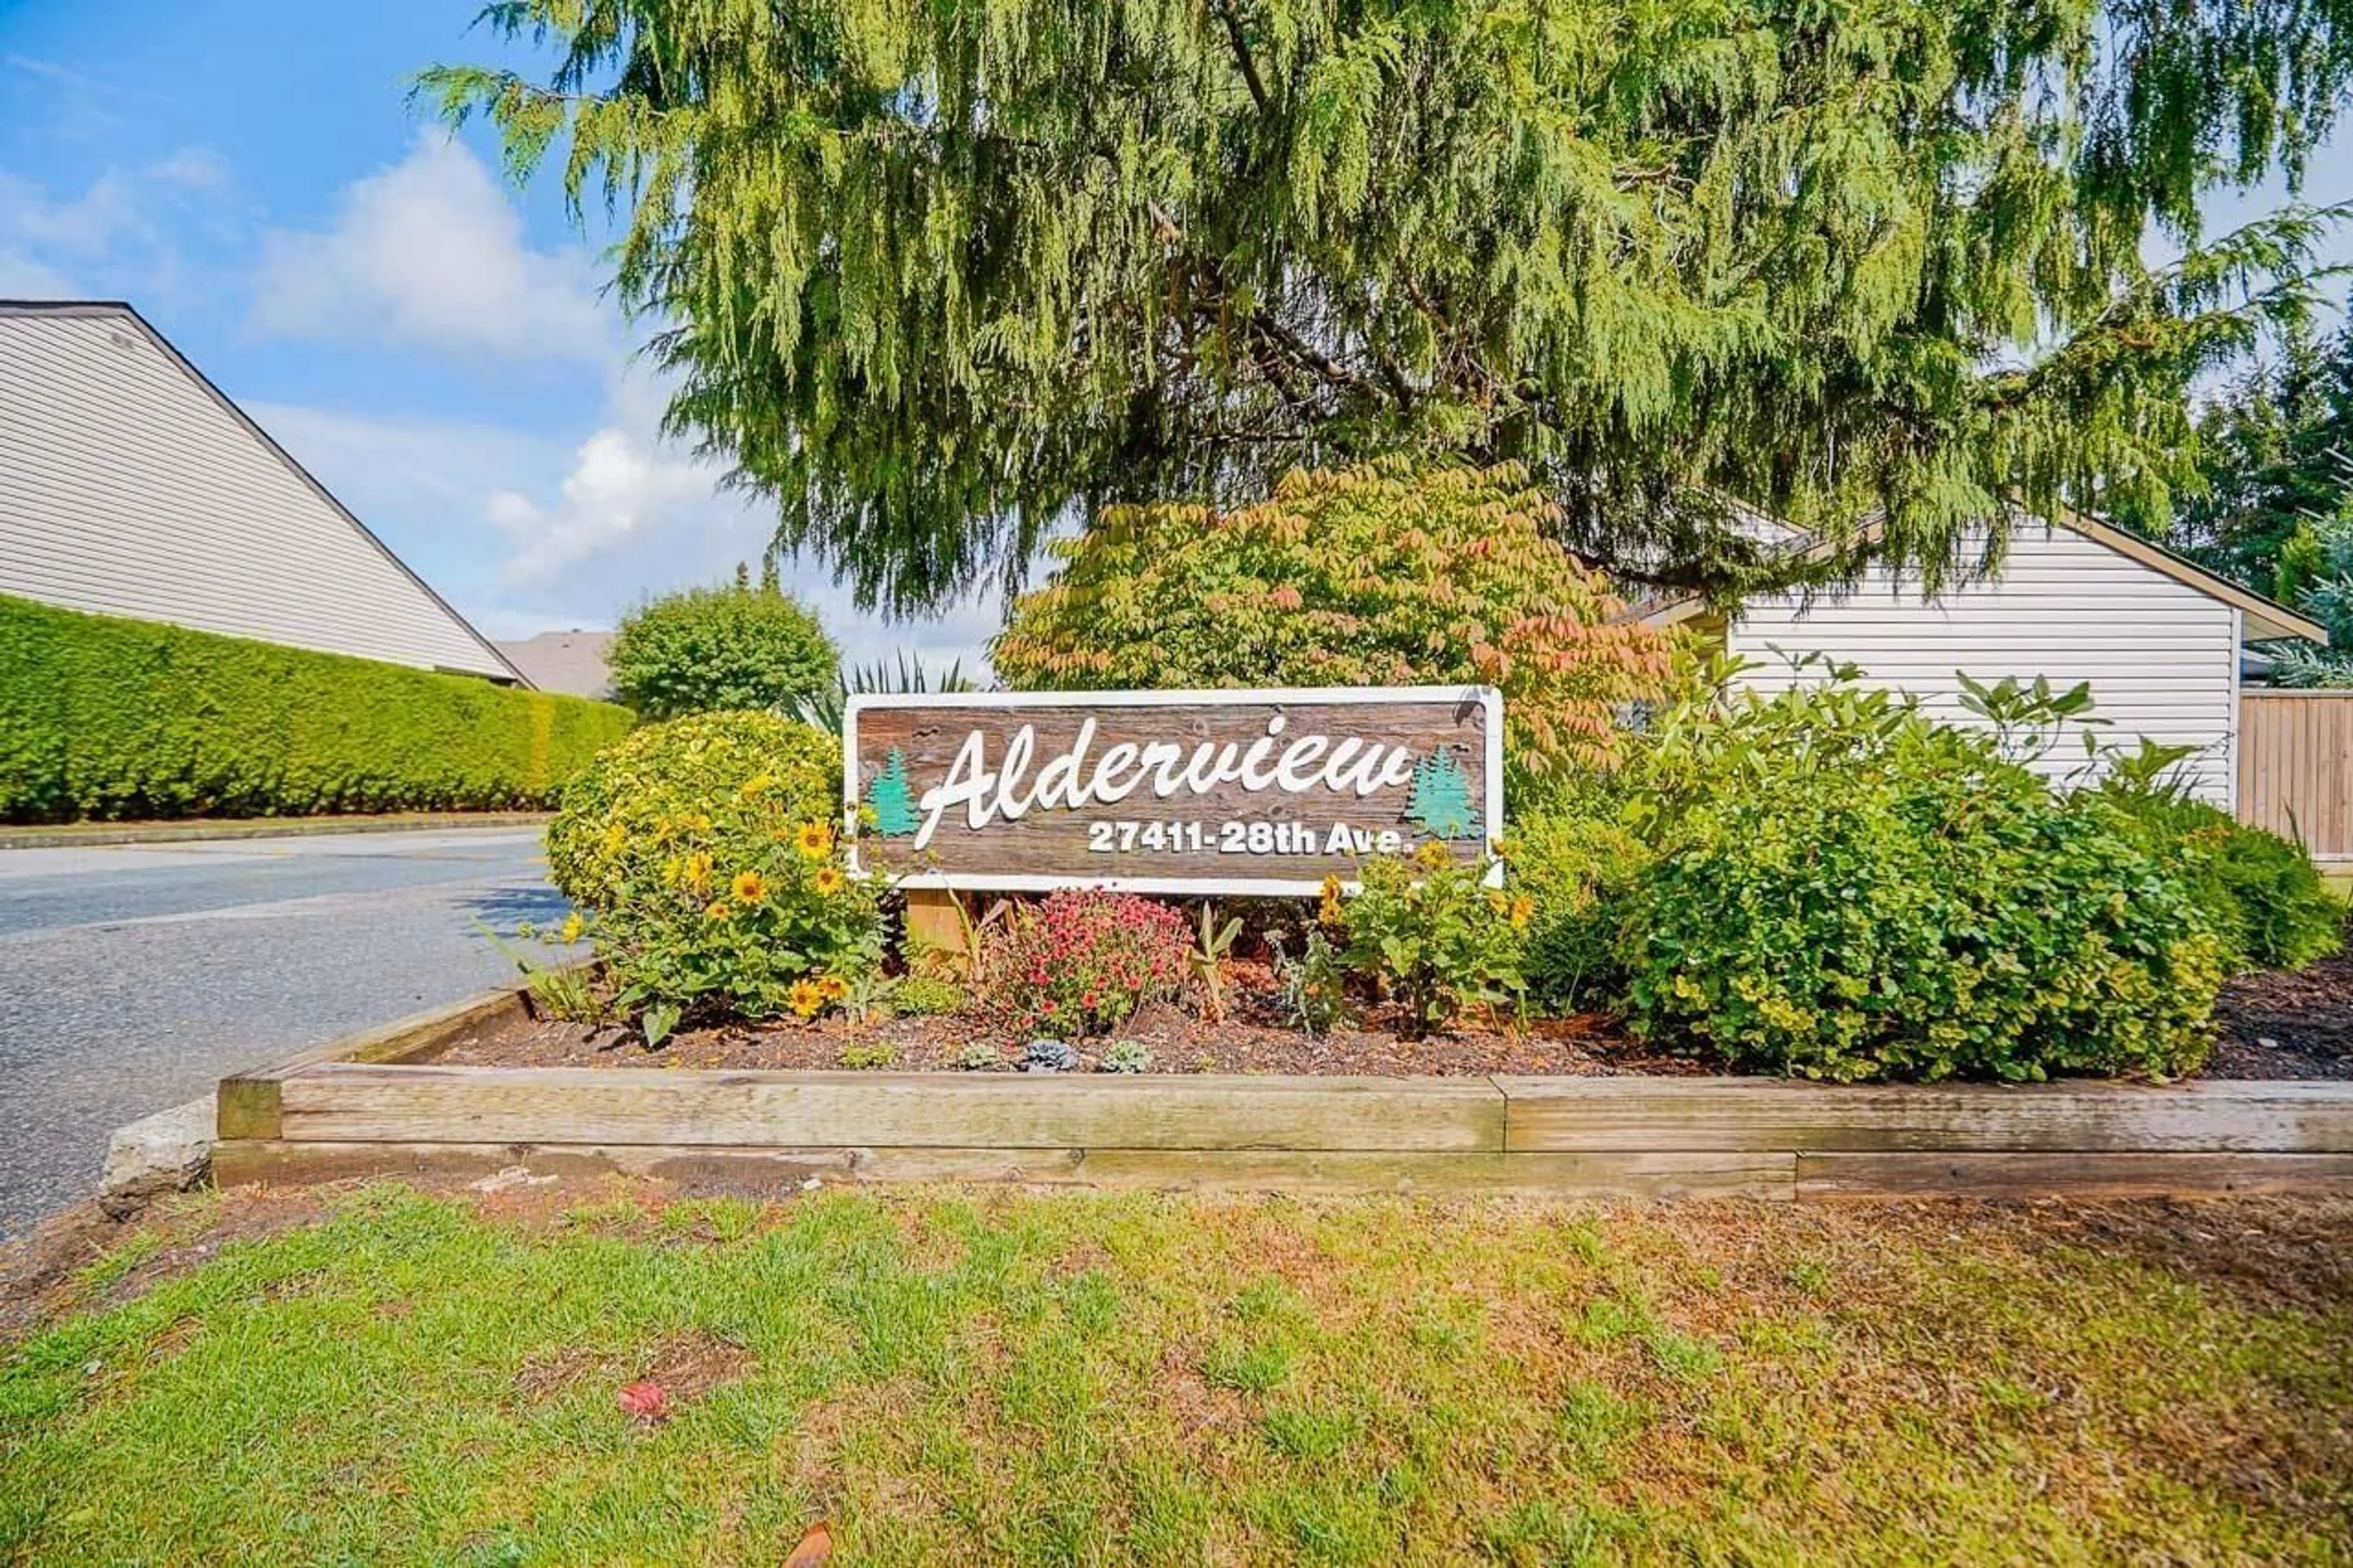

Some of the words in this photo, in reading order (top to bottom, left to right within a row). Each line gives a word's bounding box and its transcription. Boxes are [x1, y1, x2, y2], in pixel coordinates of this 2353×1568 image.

[914, 716, 1414, 849] Alderview
[1088, 821, 1316, 853] 27411-28th
[1324, 822, 1414, 854] Ave.
